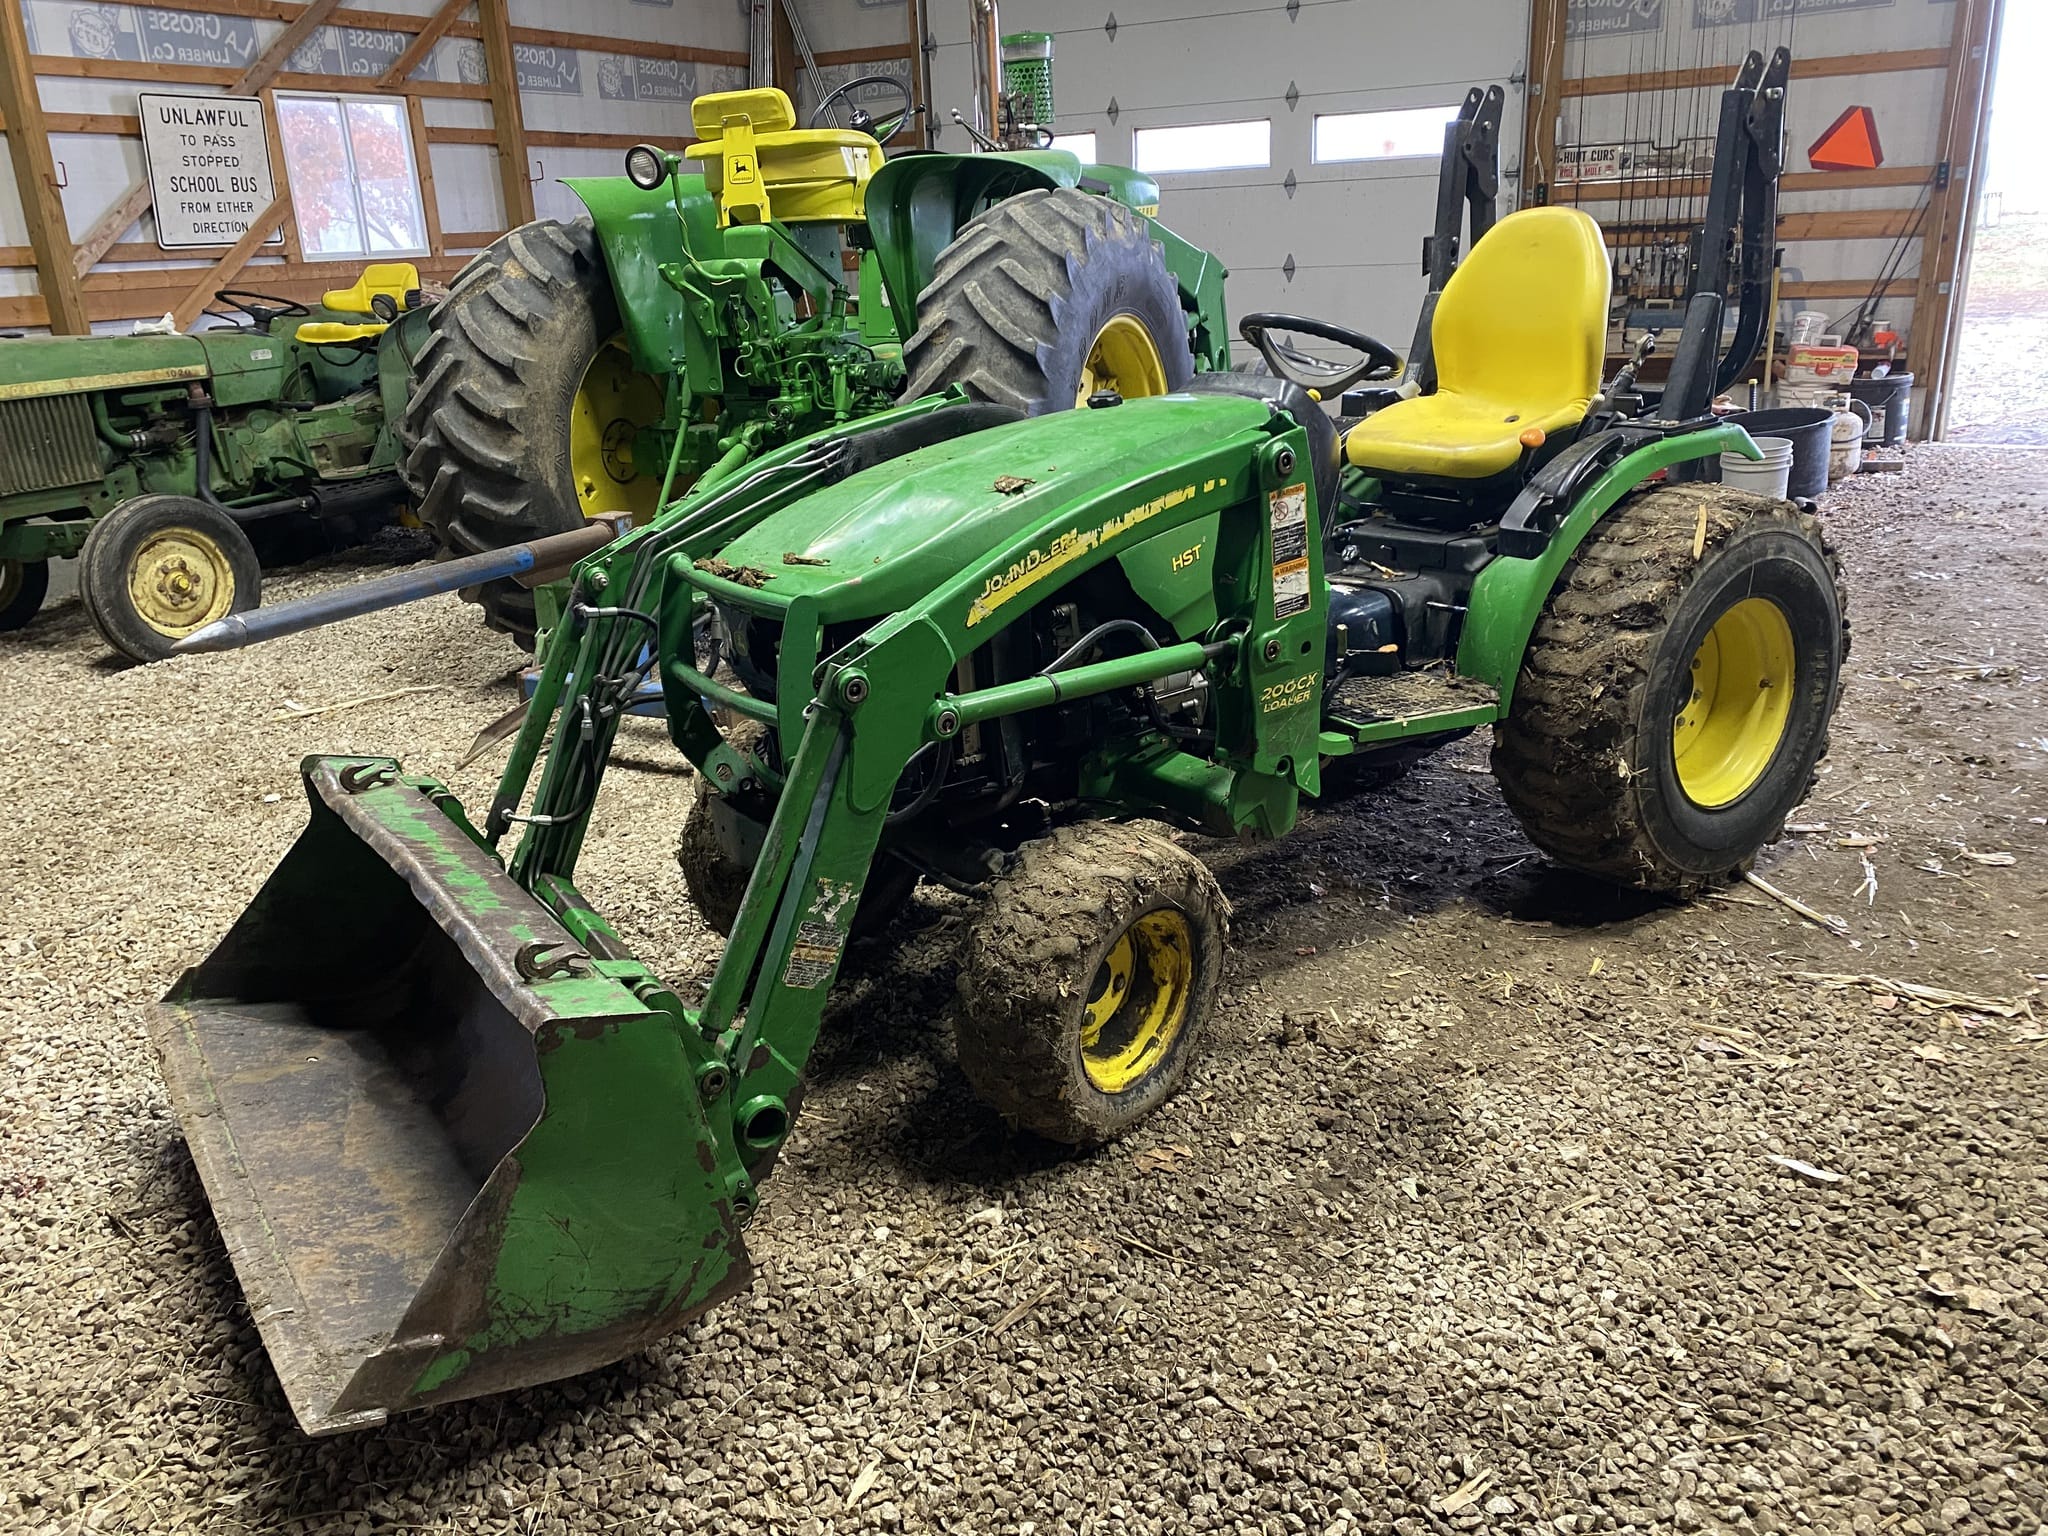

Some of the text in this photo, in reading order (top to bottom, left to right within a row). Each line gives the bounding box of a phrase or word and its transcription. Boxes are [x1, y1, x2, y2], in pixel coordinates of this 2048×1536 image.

[159, 106, 249, 128] UNLAWFUL
[180, 134, 236, 147] TO PASS
[182, 155, 240, 168] STOPPED
[1591, 149, 1615, 162] CURS
[170, 176, 258, 193] SCHOOL BUS
[181, 202, 254, 214] FROM EITHER
[192, 222, 249, 234] DIRECTION
[1172, 543, 1202, 573] HST
[1260, 671, 1319, 702] 200CX
